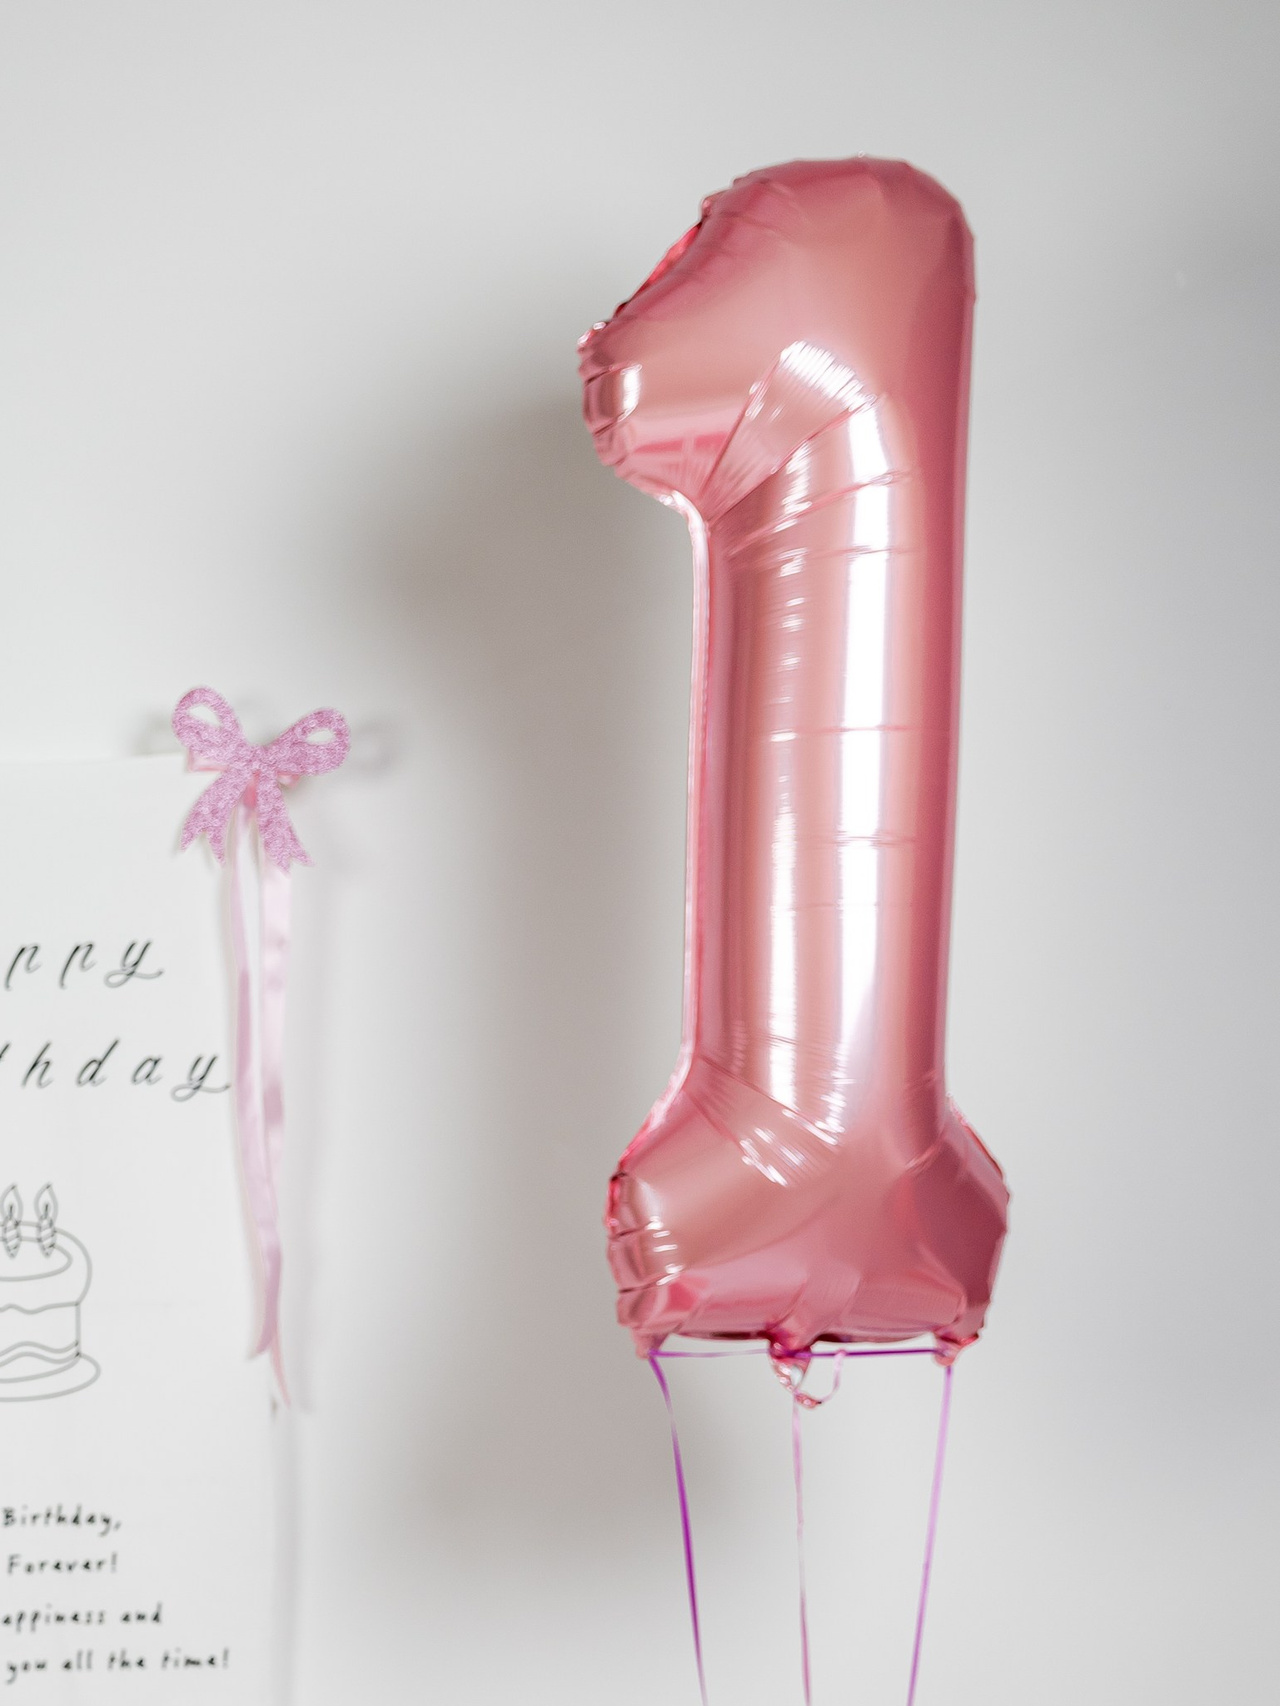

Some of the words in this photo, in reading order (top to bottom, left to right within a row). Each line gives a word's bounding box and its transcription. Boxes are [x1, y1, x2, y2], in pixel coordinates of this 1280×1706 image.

[1, 1504, 123, 1537] Birthday,
[7, 1552, 119, 1576] Forever!
[120, 1602, 163, 1625] and
[6, 1658, 48, 1685] you
[62, 1649, 94, 1672] all
[107, 1648, 145, 1670] the
[161, 1647, 230, 1670] time!
